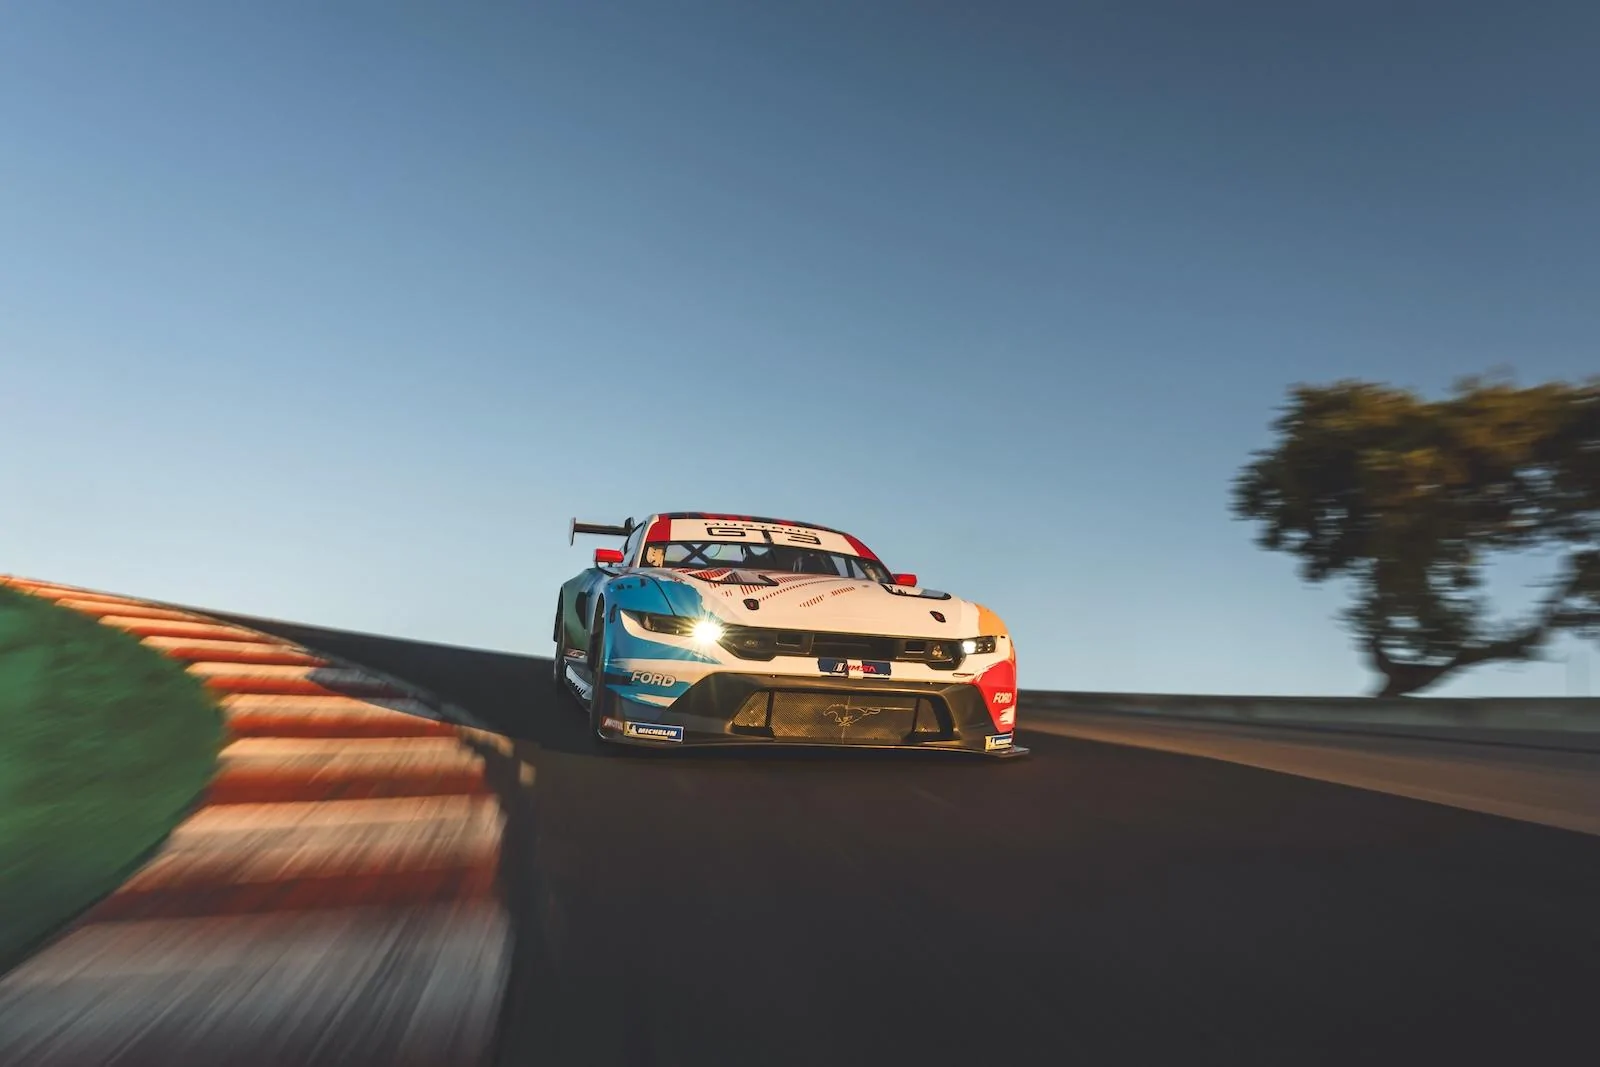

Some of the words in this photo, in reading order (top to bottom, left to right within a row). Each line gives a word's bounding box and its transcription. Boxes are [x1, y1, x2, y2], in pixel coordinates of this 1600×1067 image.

[706, 527, 821, 544] GT3
[631, 671, 676, 687] FORD
[992, 692, 1012, 704] FORD
[638, 727, 677, 737] MICHELIN
